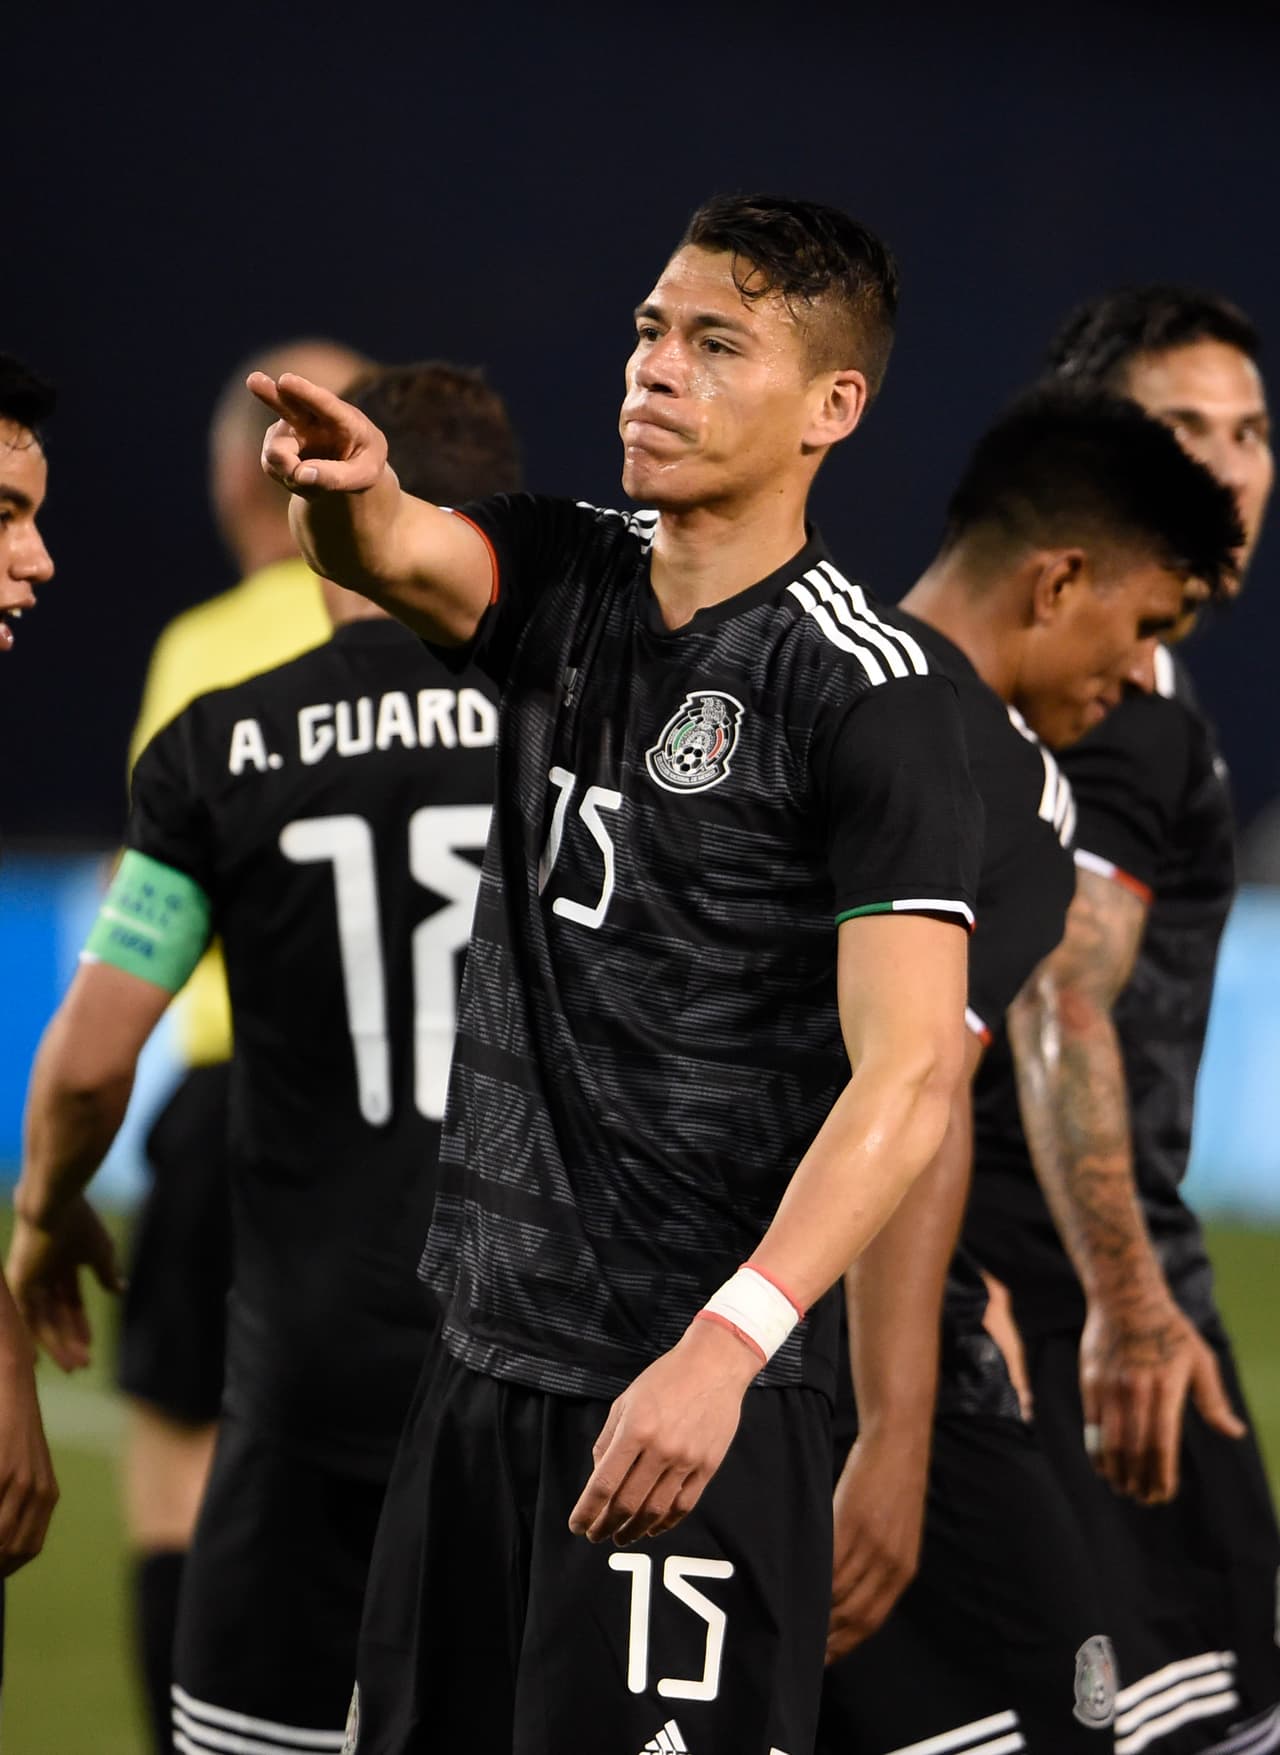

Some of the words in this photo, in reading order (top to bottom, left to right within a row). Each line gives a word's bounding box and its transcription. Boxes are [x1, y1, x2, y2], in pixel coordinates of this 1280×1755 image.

[229, 720, 283, 775] A.
[537, 766, 622, 929] 15
[608, 1552, 734, 1701] 15
